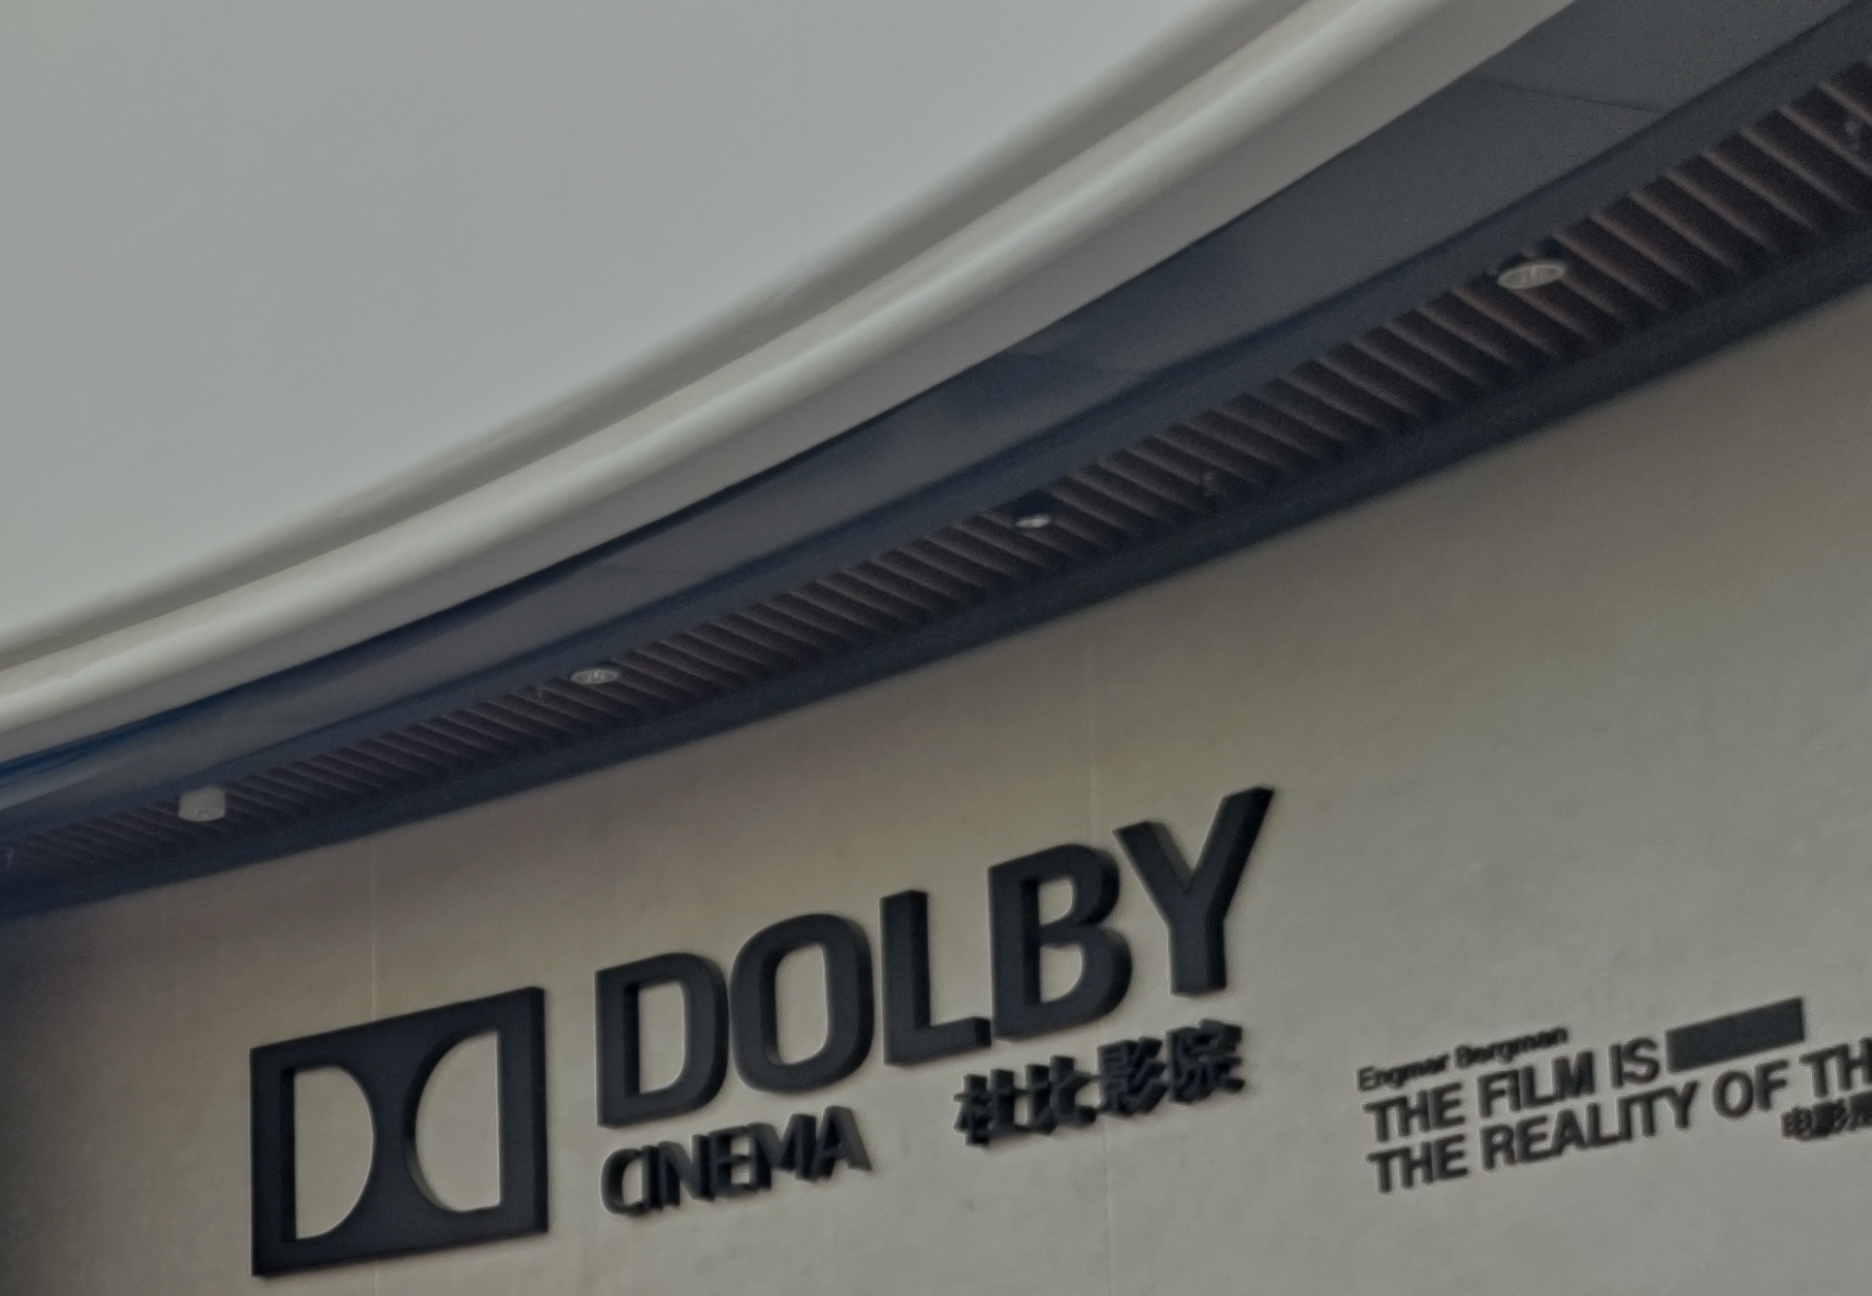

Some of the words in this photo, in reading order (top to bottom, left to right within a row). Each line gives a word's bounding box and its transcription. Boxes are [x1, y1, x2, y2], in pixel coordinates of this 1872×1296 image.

[595, 786, 1275, 1130] DOLBY
[953, 1018, 1246, 1149] 杜比影院
[1363, 1082, 1467, 1143] THE
[1477, 1050, 1597, 1118] FILM
[1609, 1036, 1661, 1089] IS
[1367, 1134, 1470, 1194] THE
[1479, 1080, 1699, 1171] REALITY
[1712, 1059, 1790, 1119] OF
[601, 1105, 873, 1217] CINEMA
